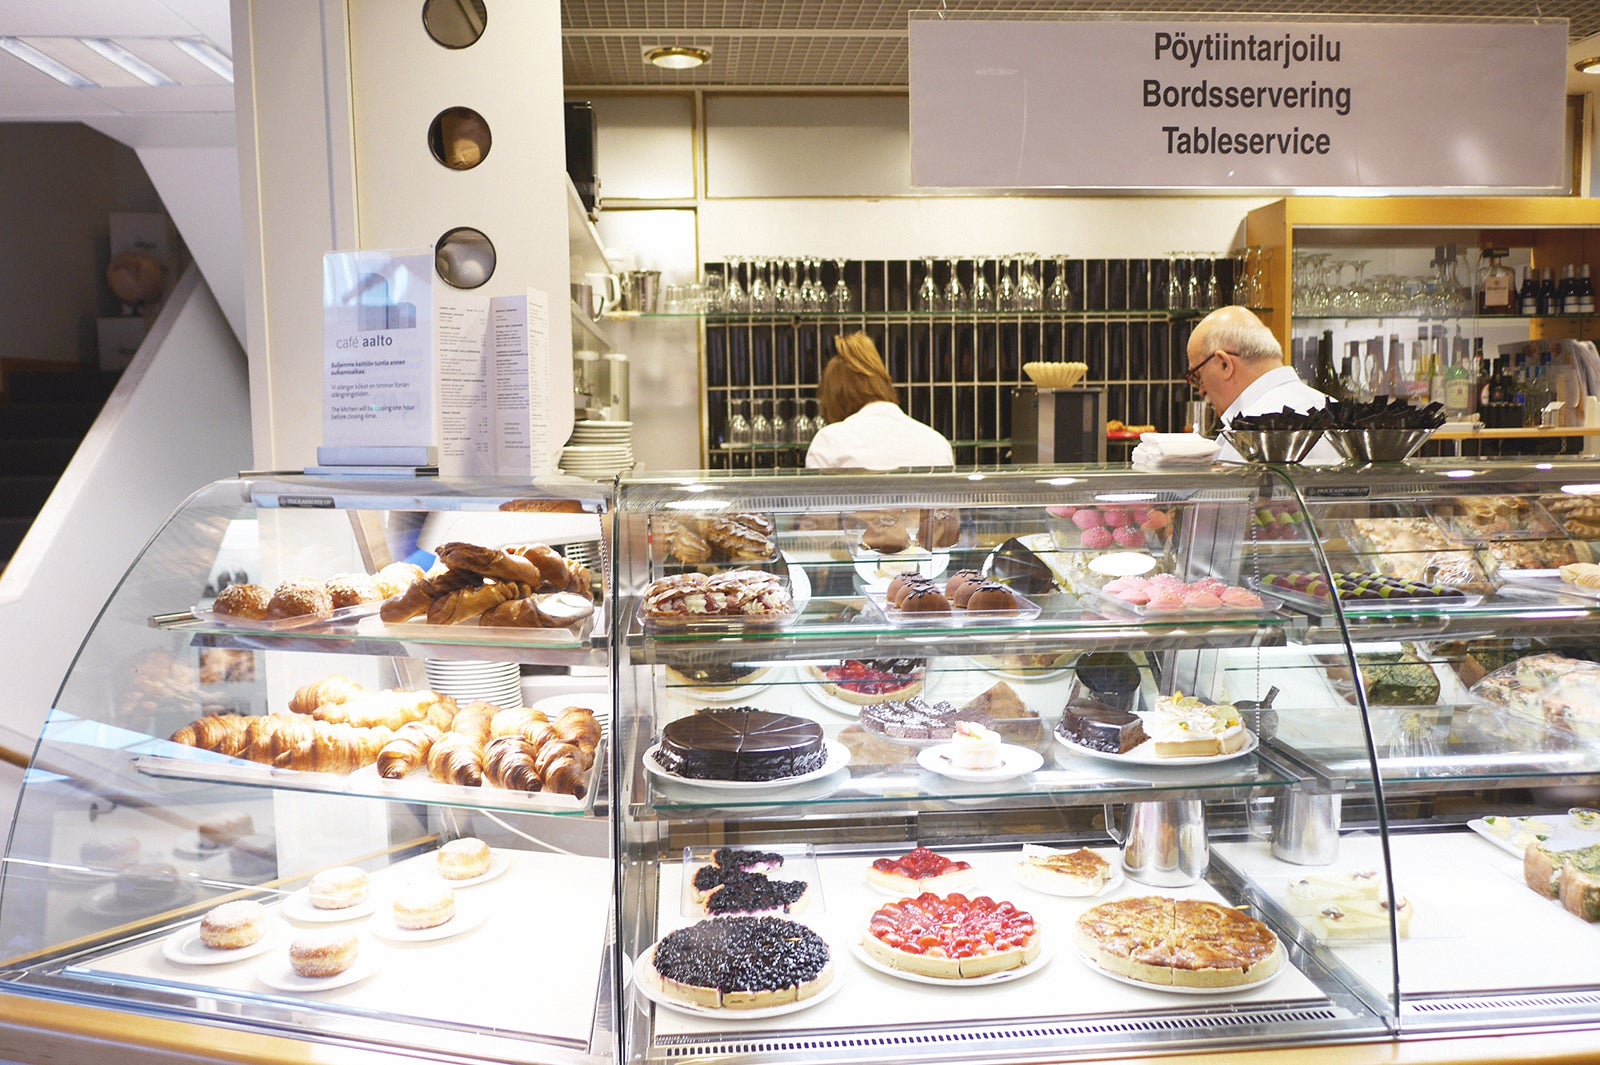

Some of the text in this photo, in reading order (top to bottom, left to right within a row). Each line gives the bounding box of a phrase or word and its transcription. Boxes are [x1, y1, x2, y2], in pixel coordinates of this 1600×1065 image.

[1155, 32, 1341, 69] Pöytiintarjoilu
[1143, 79, 1351, 116] Bordsservering
[1162, 126, 1331, 155] Tableservice
[336, 334, 393, 349] café aalto
[331, 413, 346, 421] before
[402, 403, 415, 411] hour
